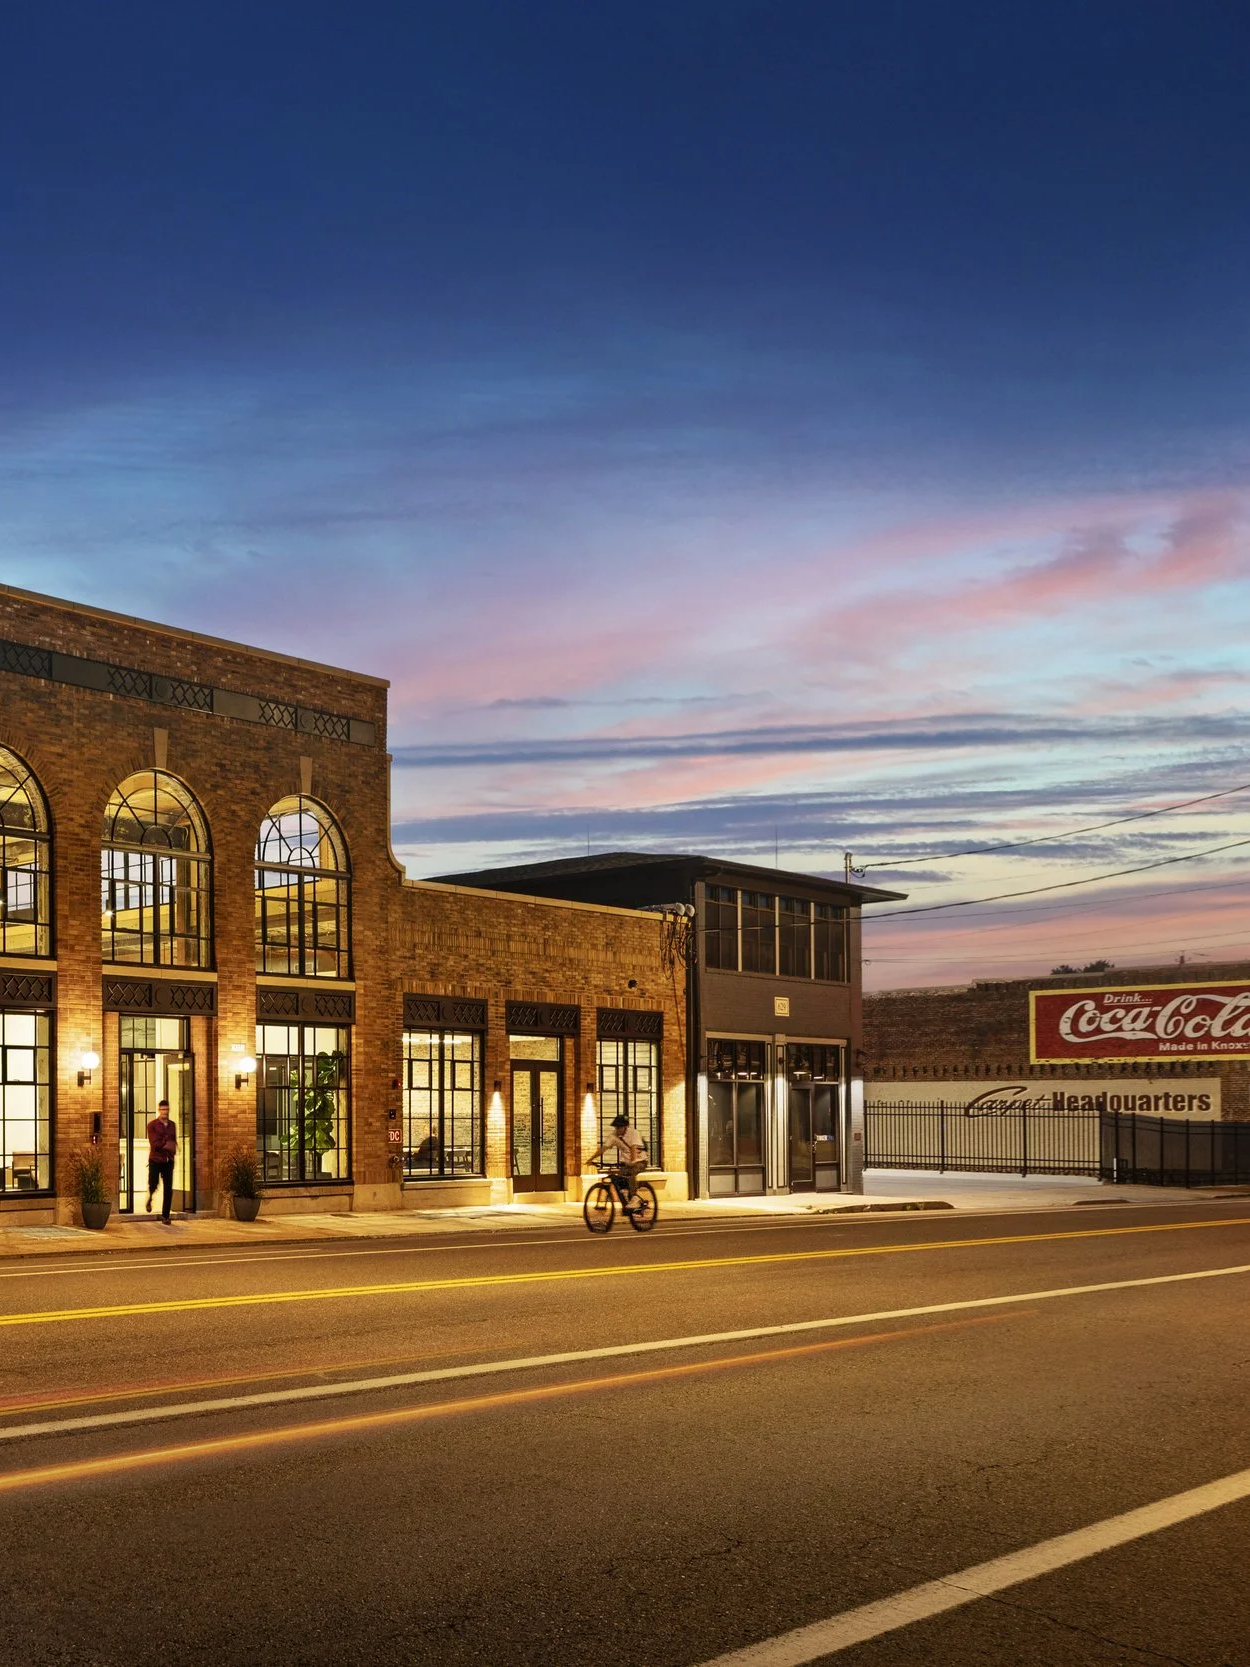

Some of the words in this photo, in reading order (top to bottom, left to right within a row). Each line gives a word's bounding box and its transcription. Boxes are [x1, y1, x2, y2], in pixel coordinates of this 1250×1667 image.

[1159, 1042, 1194, 1052] Made
[1197, 1041, 1208, 1050] in
[964, 1086, 1051, 1118] Carpet
[1052, 1092, 1211, 1113] Headquarters
